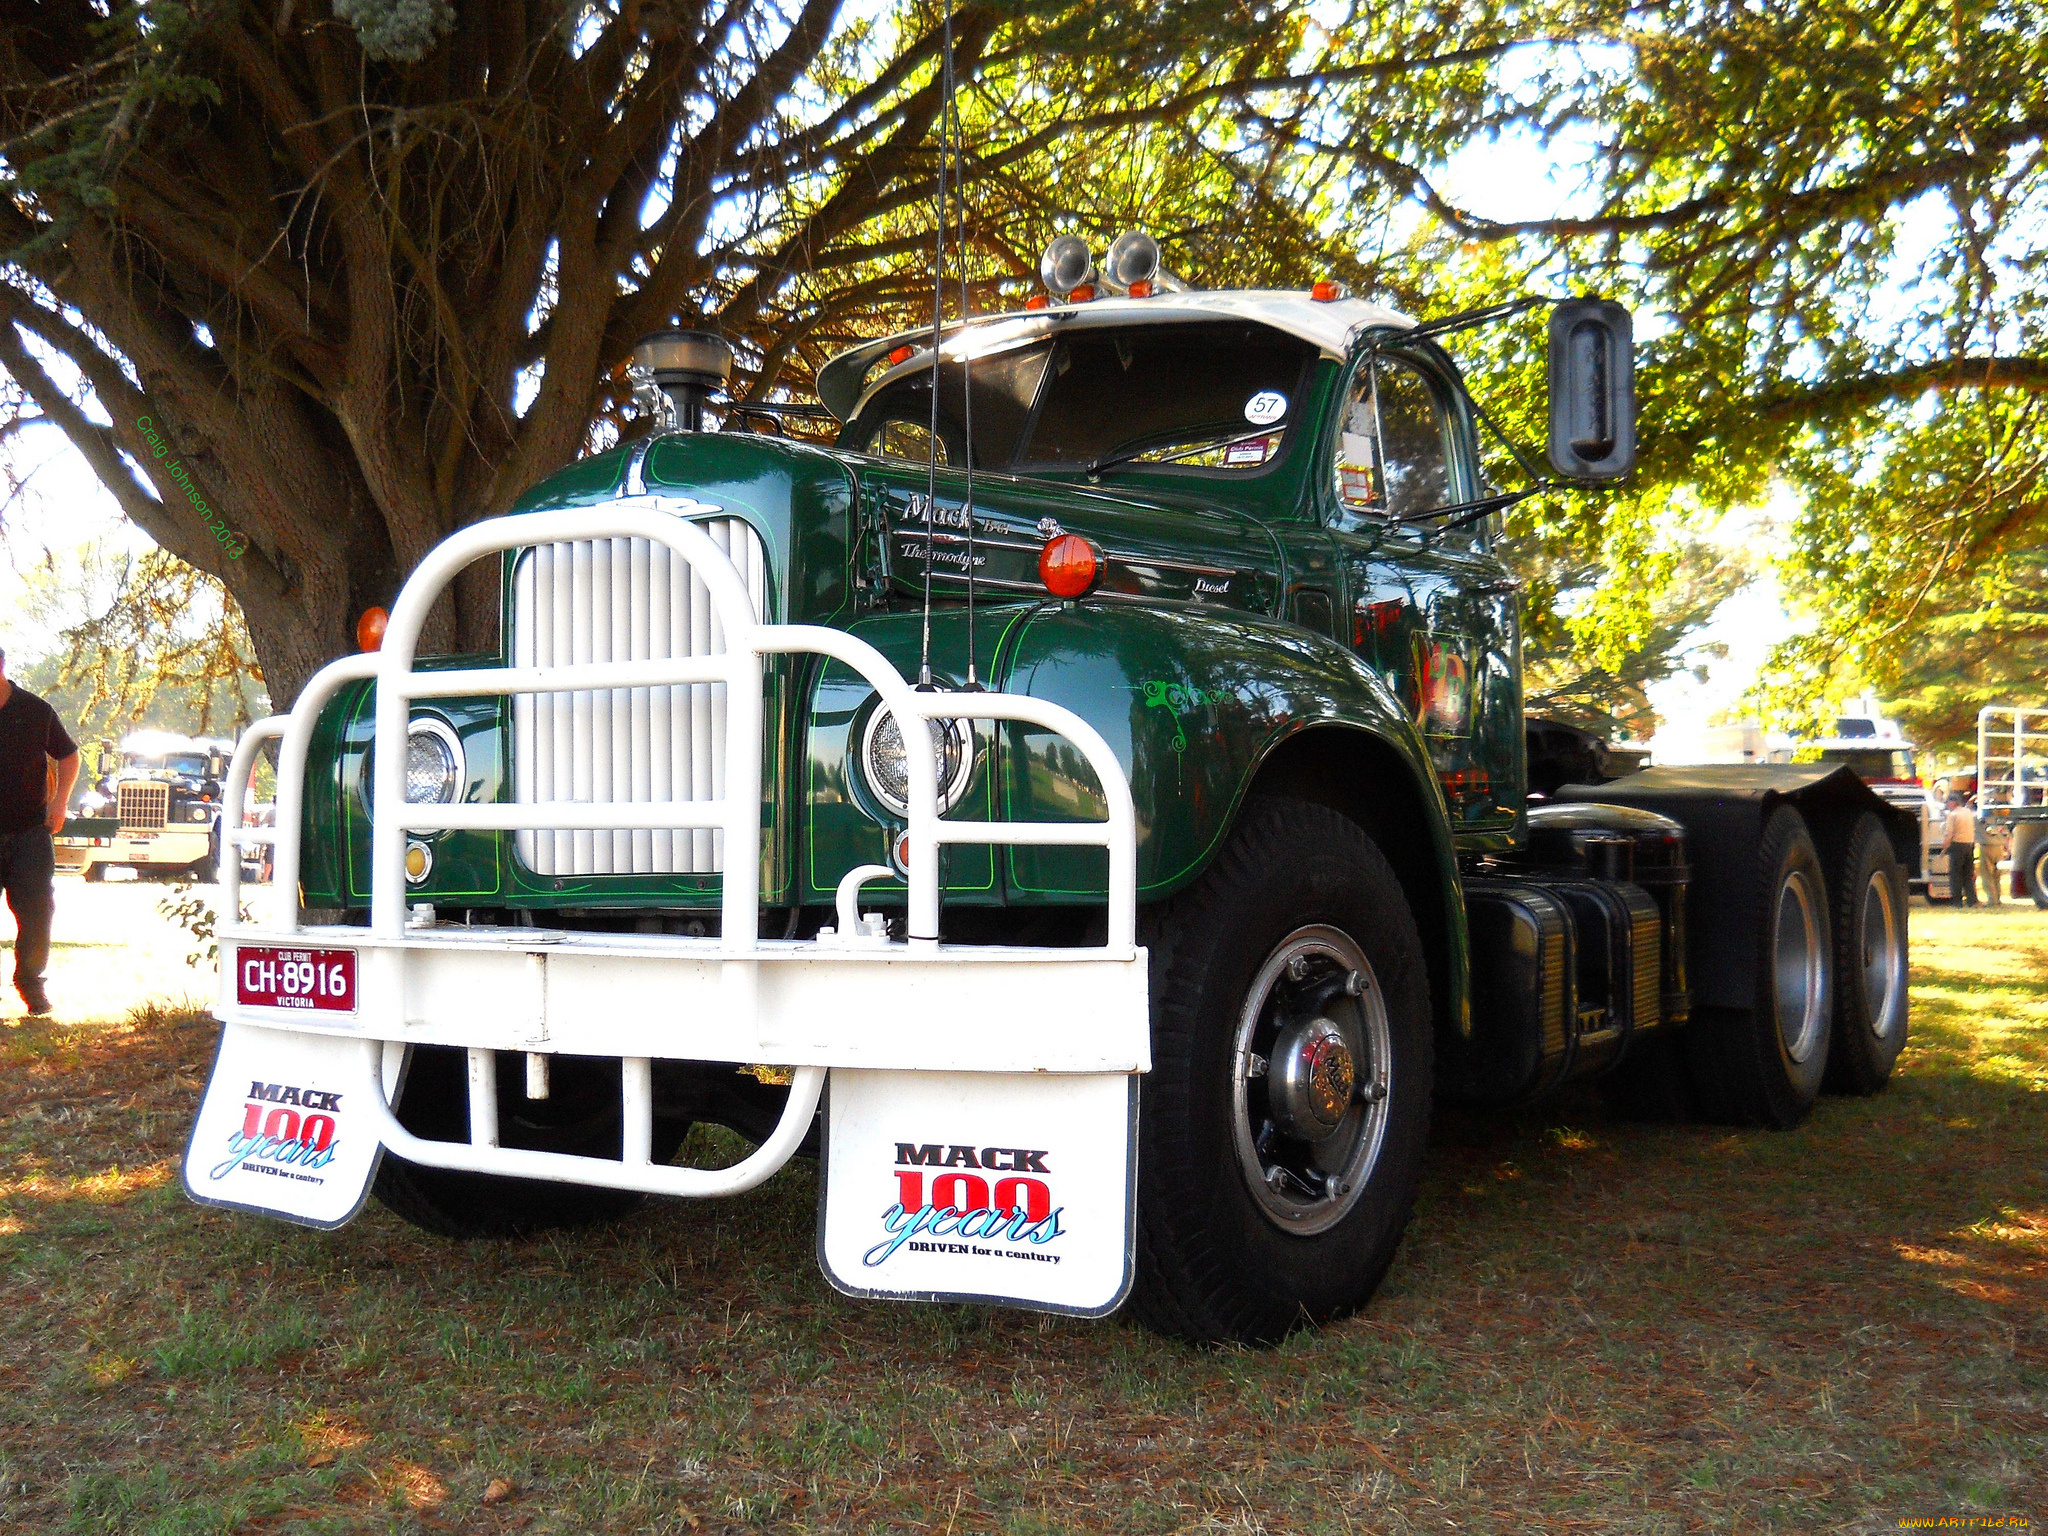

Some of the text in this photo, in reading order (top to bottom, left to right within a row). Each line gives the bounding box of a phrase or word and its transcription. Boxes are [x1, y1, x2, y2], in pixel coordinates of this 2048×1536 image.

[1253, 397, 1279, 413] 57
[900, 491, 975, 529] Mack
[900, 543, 987, 572] Themodyne
[1194, 577, 1230, 594] Diesel
[278, 951, 312, 963] CLUB PERMIT
[276, 996, 315, 1008] VICTORIA
[247, 1080, 343, 1112] MACK
[242, 1103, 336, 1152] 100
[209, 1129, 341, 1181] years
[894, 1142, 1051, 1174] MACK
[241, 1162, 279, 1176] DRIVEN
[279, 1169, 290, 1178] for
[295, 1173, 325, 1186] century
[894, 1170, 1050, 1223] 100
[862, 1202, 1067, 1267] years
[908, 1241, 1061, 1265] DRIVEN for a century
